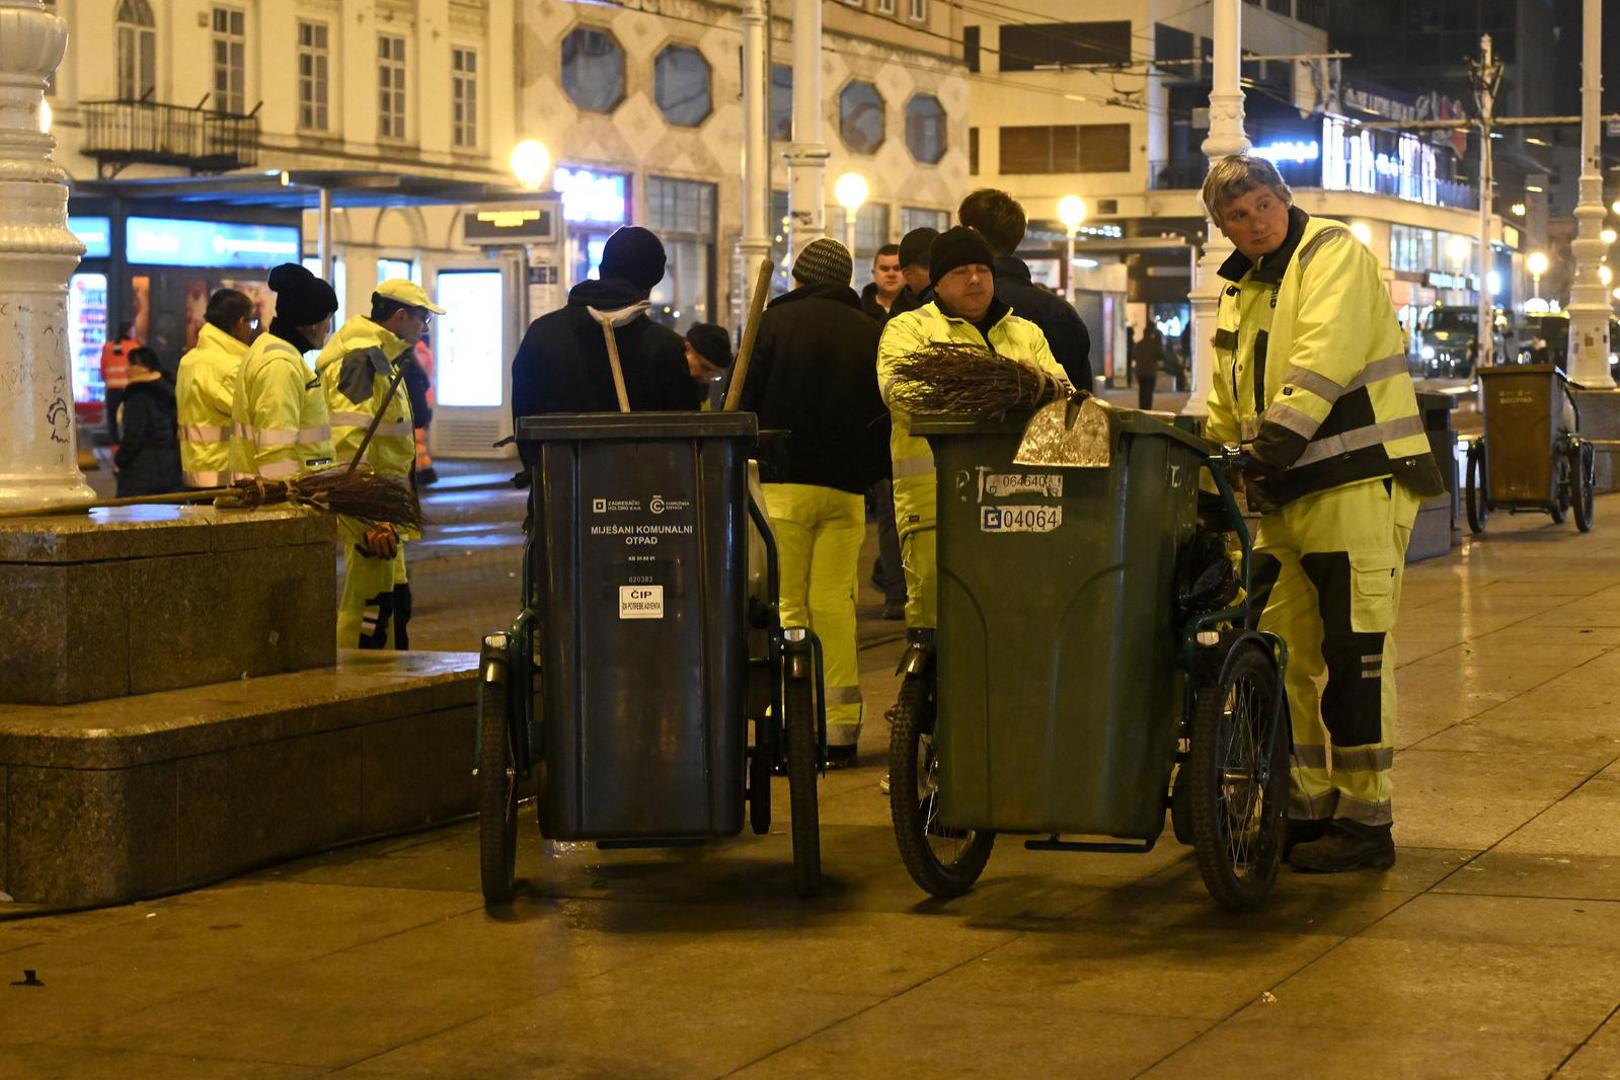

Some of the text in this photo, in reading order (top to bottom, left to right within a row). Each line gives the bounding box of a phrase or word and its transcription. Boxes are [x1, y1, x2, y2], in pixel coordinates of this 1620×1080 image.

[1003, 510, 1057, 528] 04064
[591, 524, 693, 535] MIJEŠANI KOMUNALNI
[625, 536, 658, 545] OTPAD
[630, 588, 653, 599] ČIP
